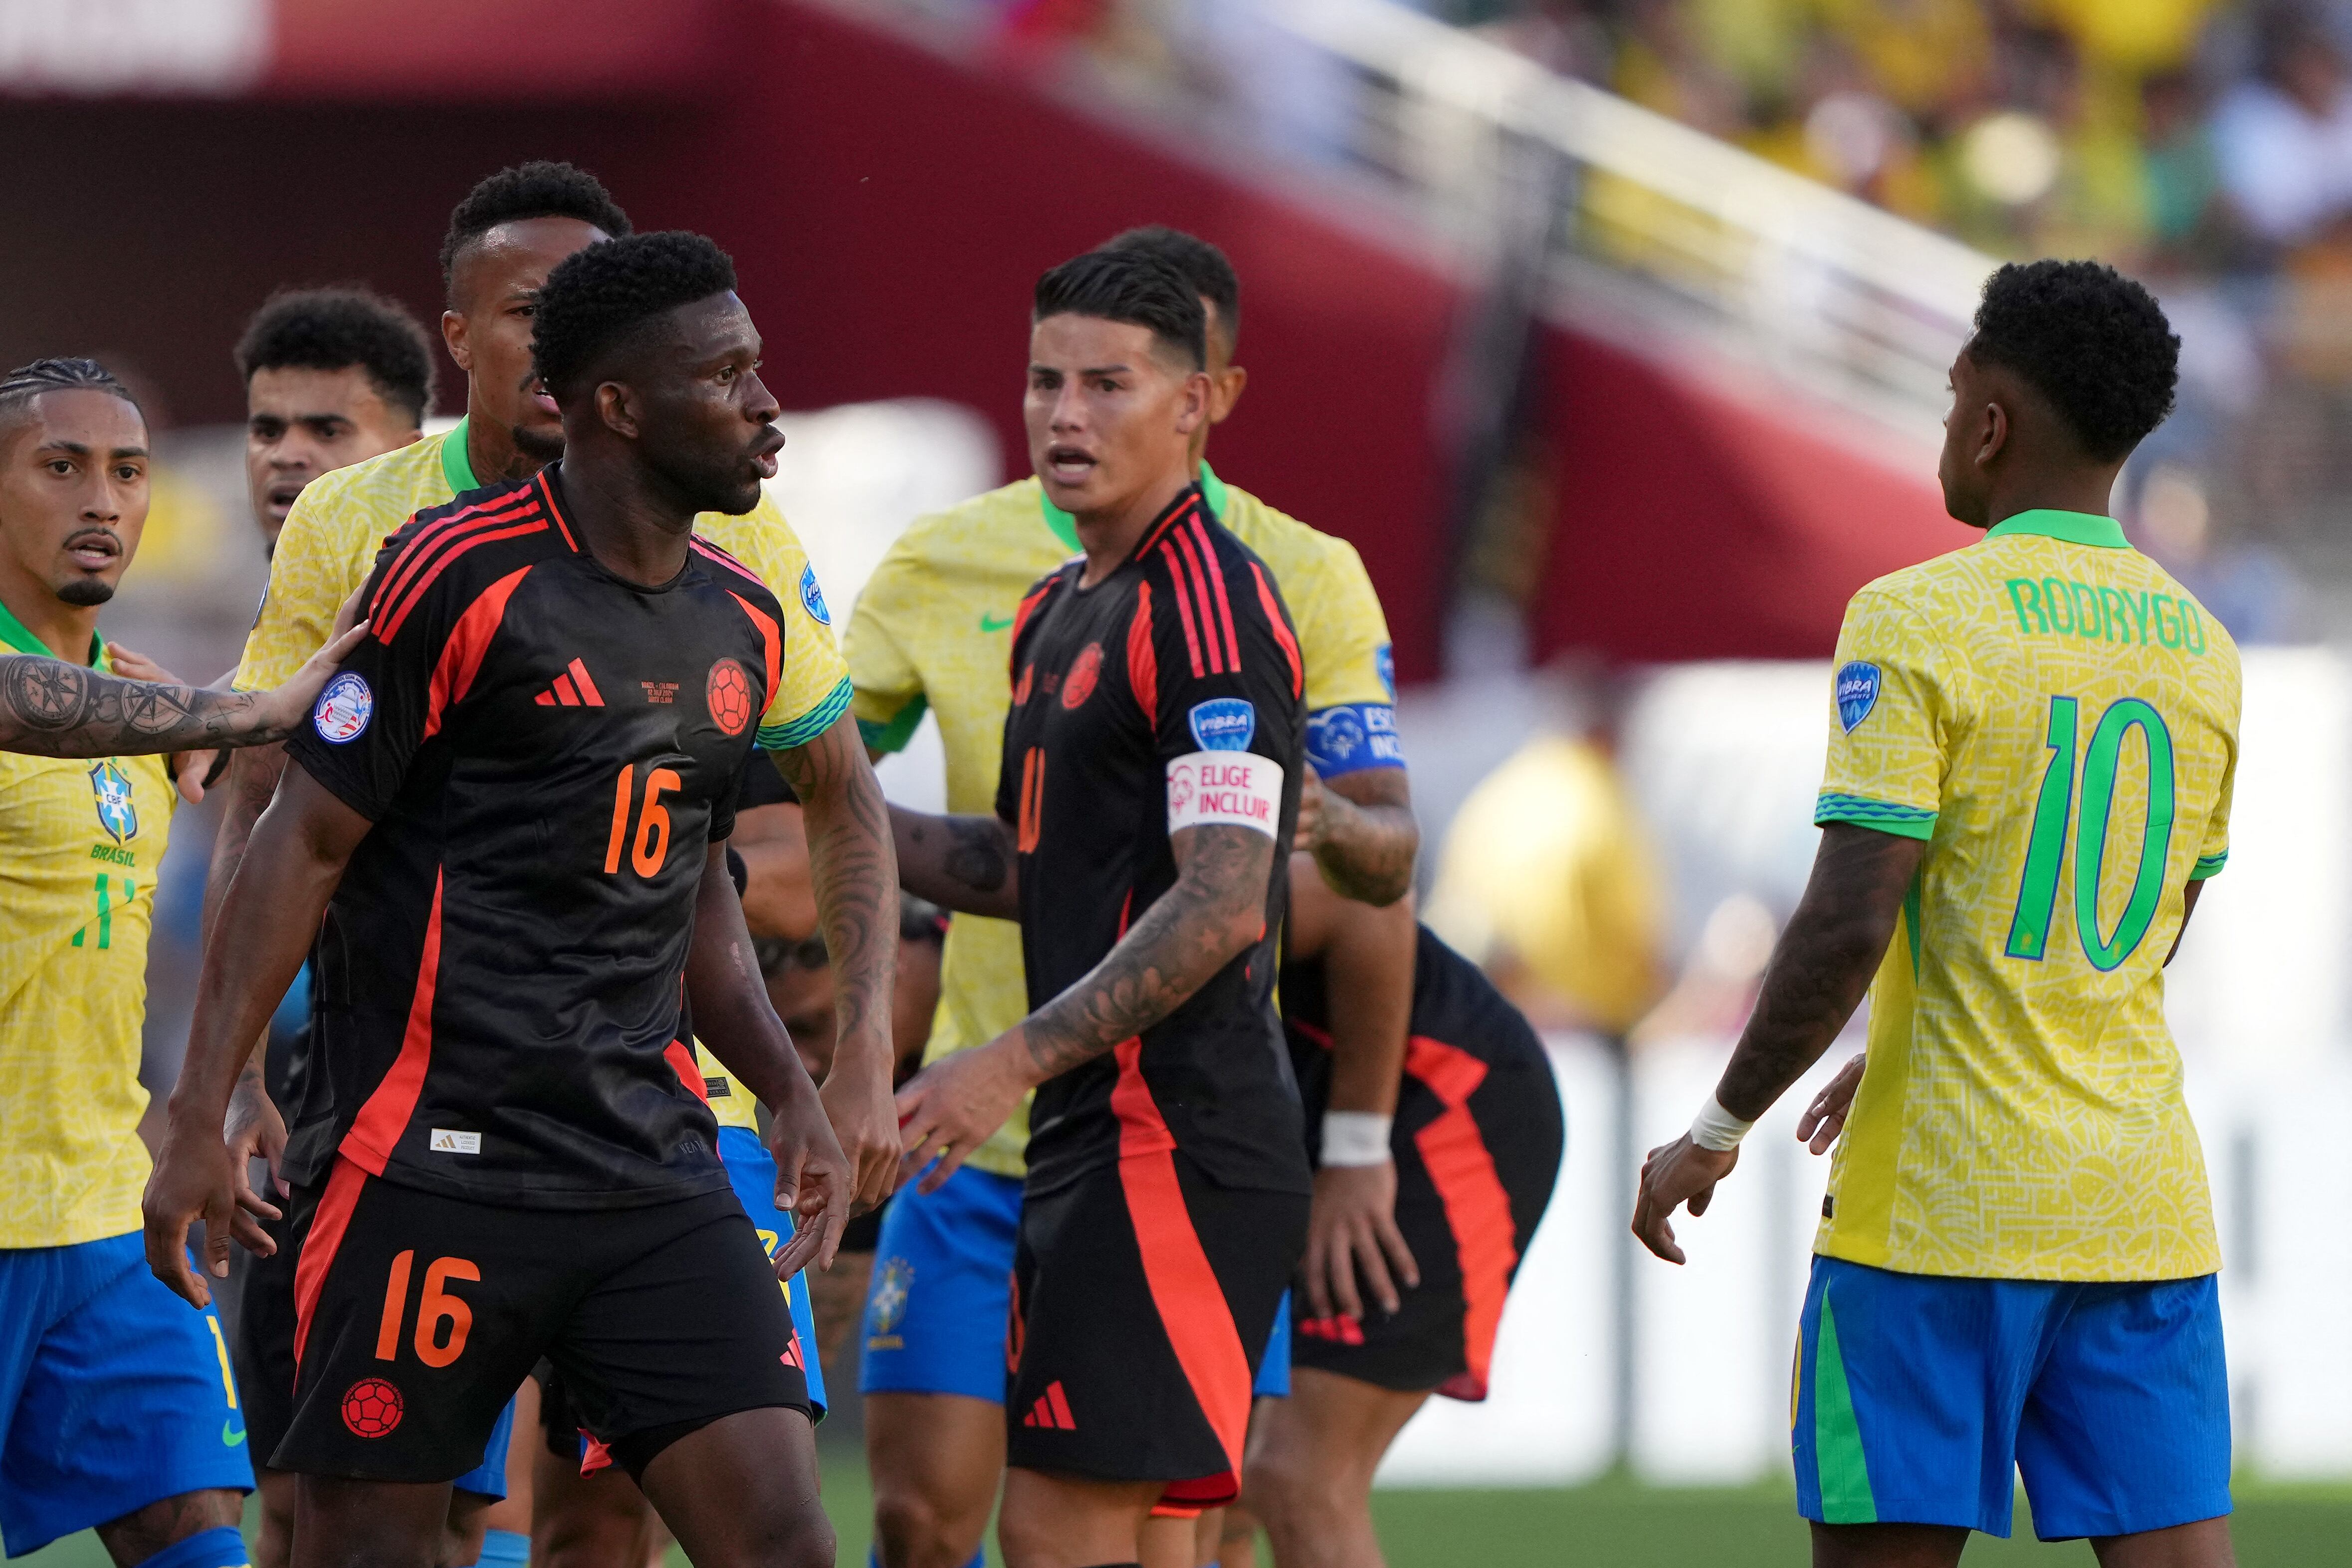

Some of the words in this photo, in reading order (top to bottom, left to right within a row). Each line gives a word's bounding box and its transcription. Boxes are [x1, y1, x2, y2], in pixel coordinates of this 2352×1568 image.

[2006, 578, 2205, 656] RODRYGO
[107, 794, 121, 805] CBF
[1200, 765, 1253, 788] ELIGE
[604, 764, 681, 879] 16
[1200, 792, 1270, 822] INCLUIR
[2004, 695, 2175, 973] 10
[91, 844, 135, 867] BRASIL
[375, 1249, 481, 1368] 16
